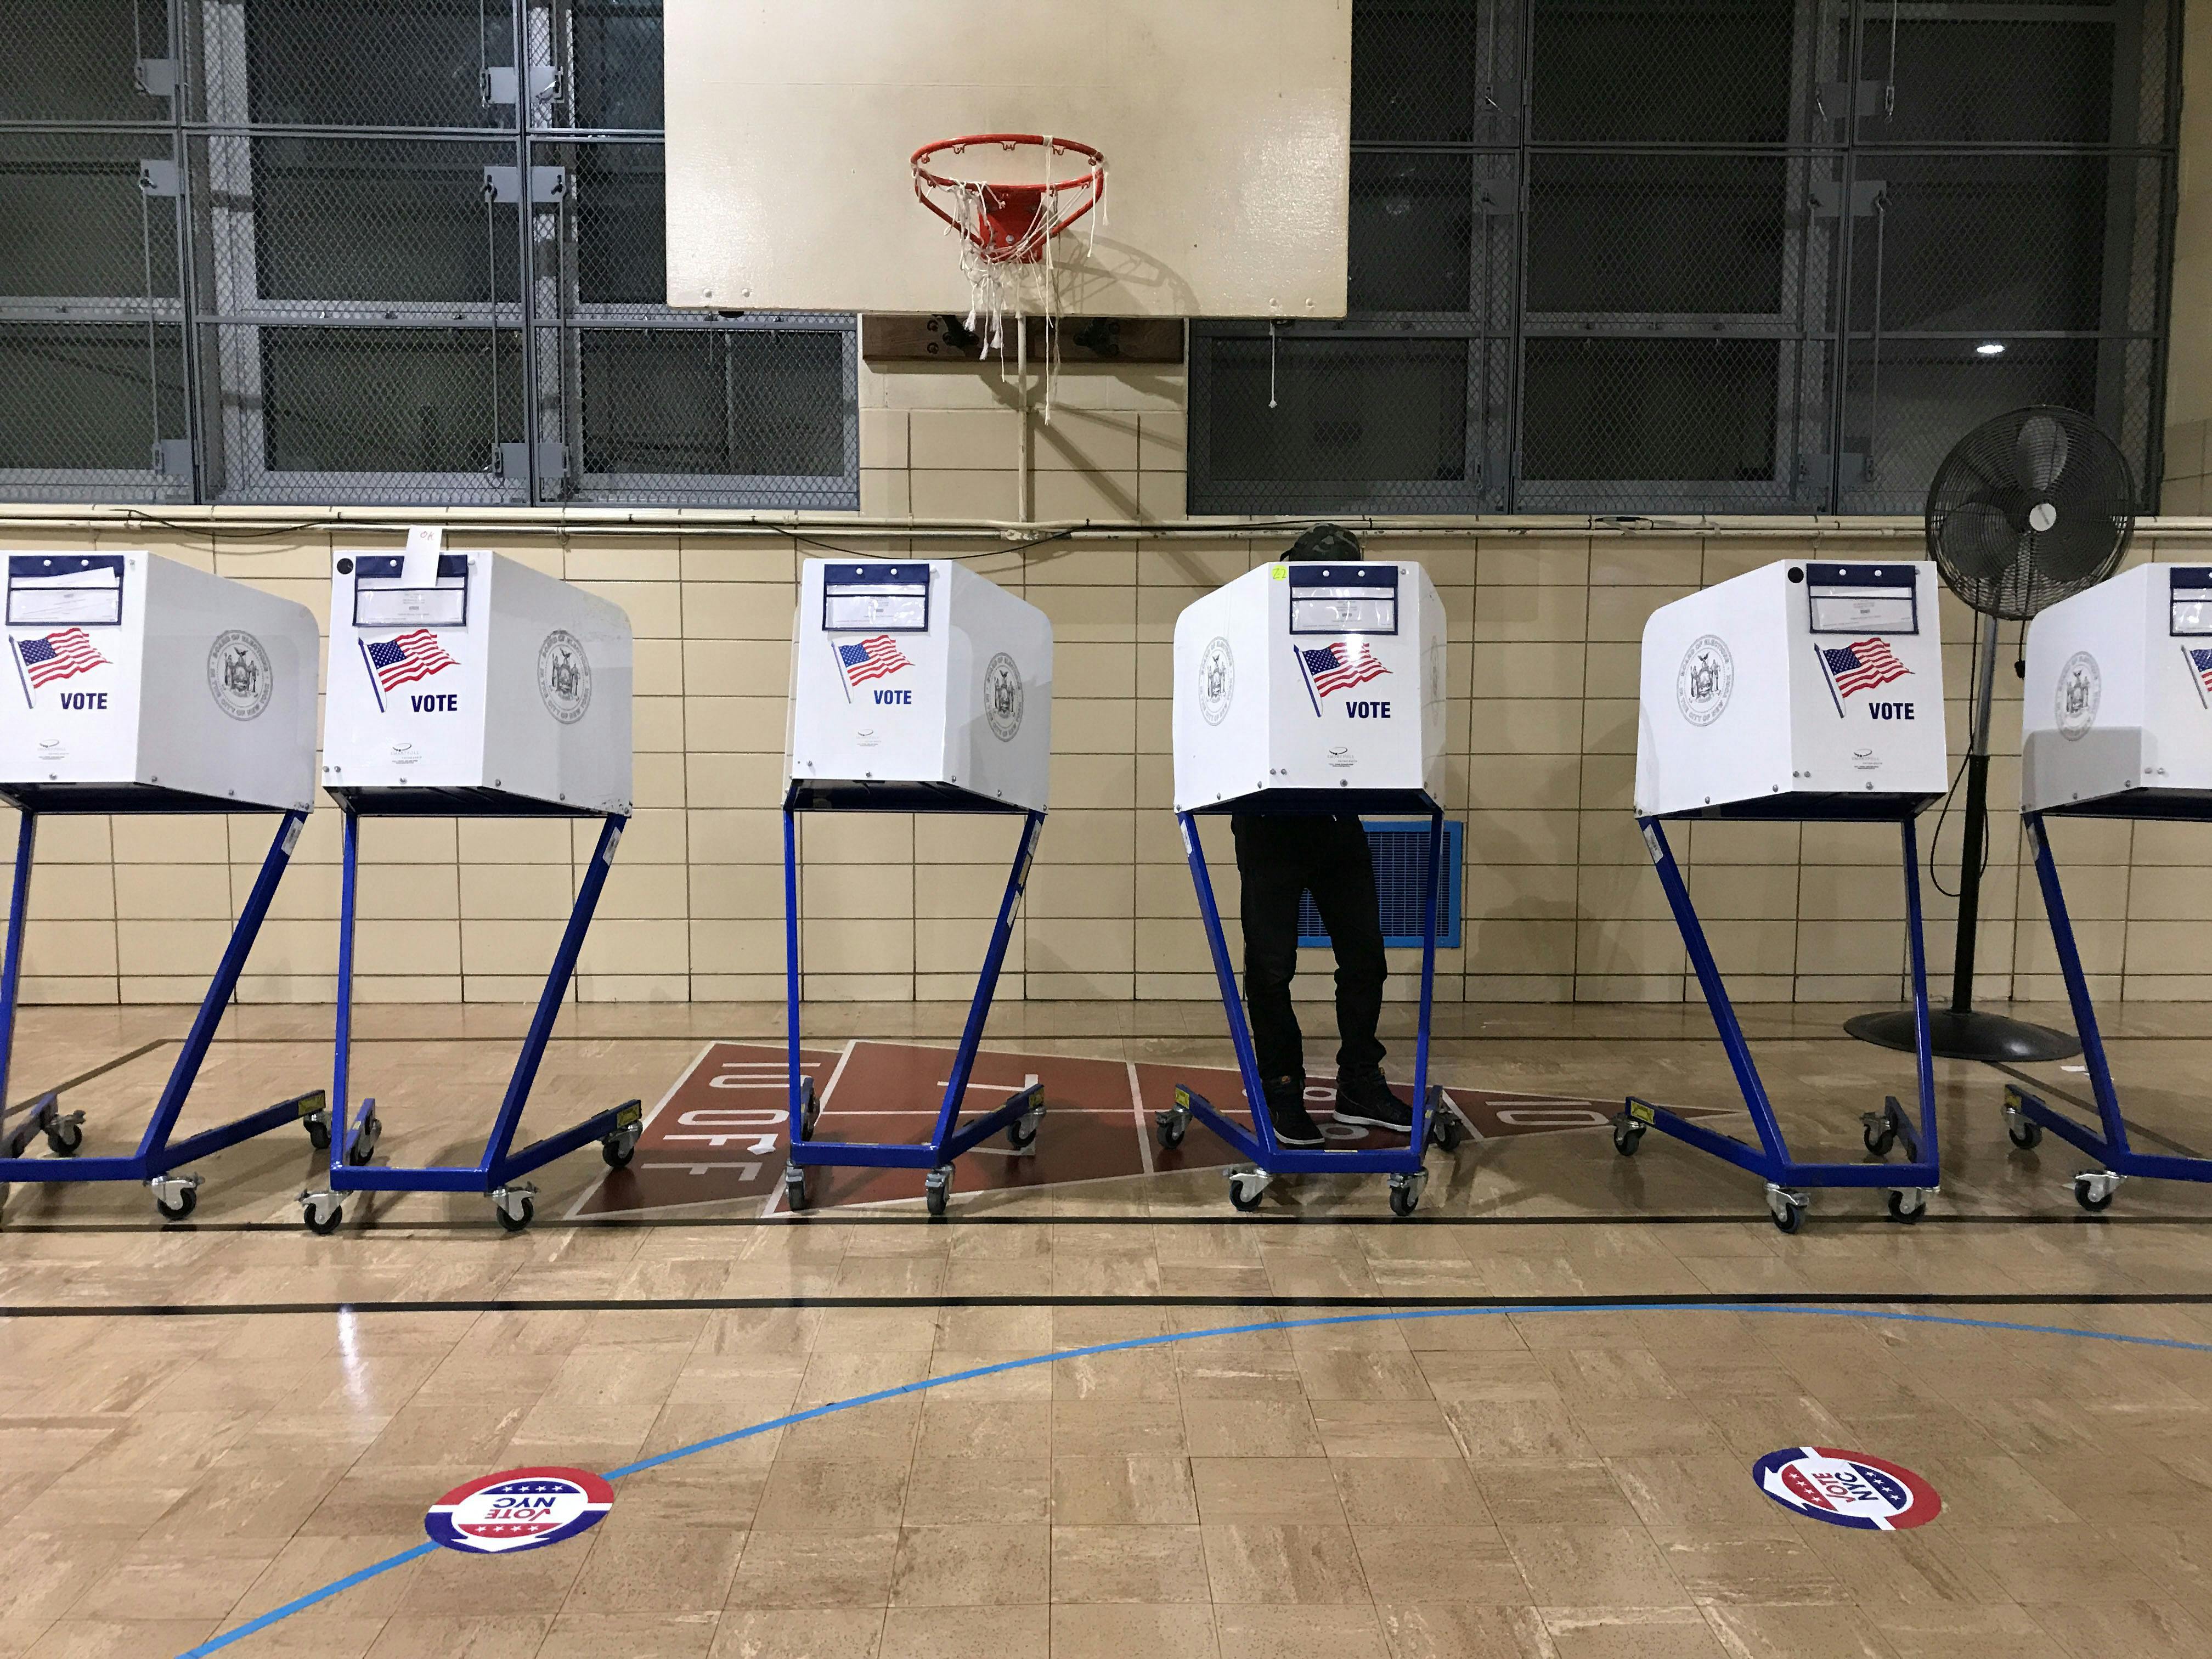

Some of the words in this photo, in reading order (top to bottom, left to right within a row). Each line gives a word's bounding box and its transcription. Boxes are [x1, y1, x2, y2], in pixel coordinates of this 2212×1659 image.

[420, 531, 434, 540] OK
[61, 693, 108, 709] VOTE
[411, 695, 458, 712] VOTE
[874, 690, 912, 704] VOTE
[1346, 702, 1391, 719] VOTE
[1869, 703, 1915, 720] VOTE
[640, 1109, 790, 1181] OFF
[1812, 1472, 1857, 1503] VOTE
[1835, 1471, 1878, 1501] NYC
[493, 1497, 556, 1508] NYC
[484, 1508, 551, 1522] VOTE
